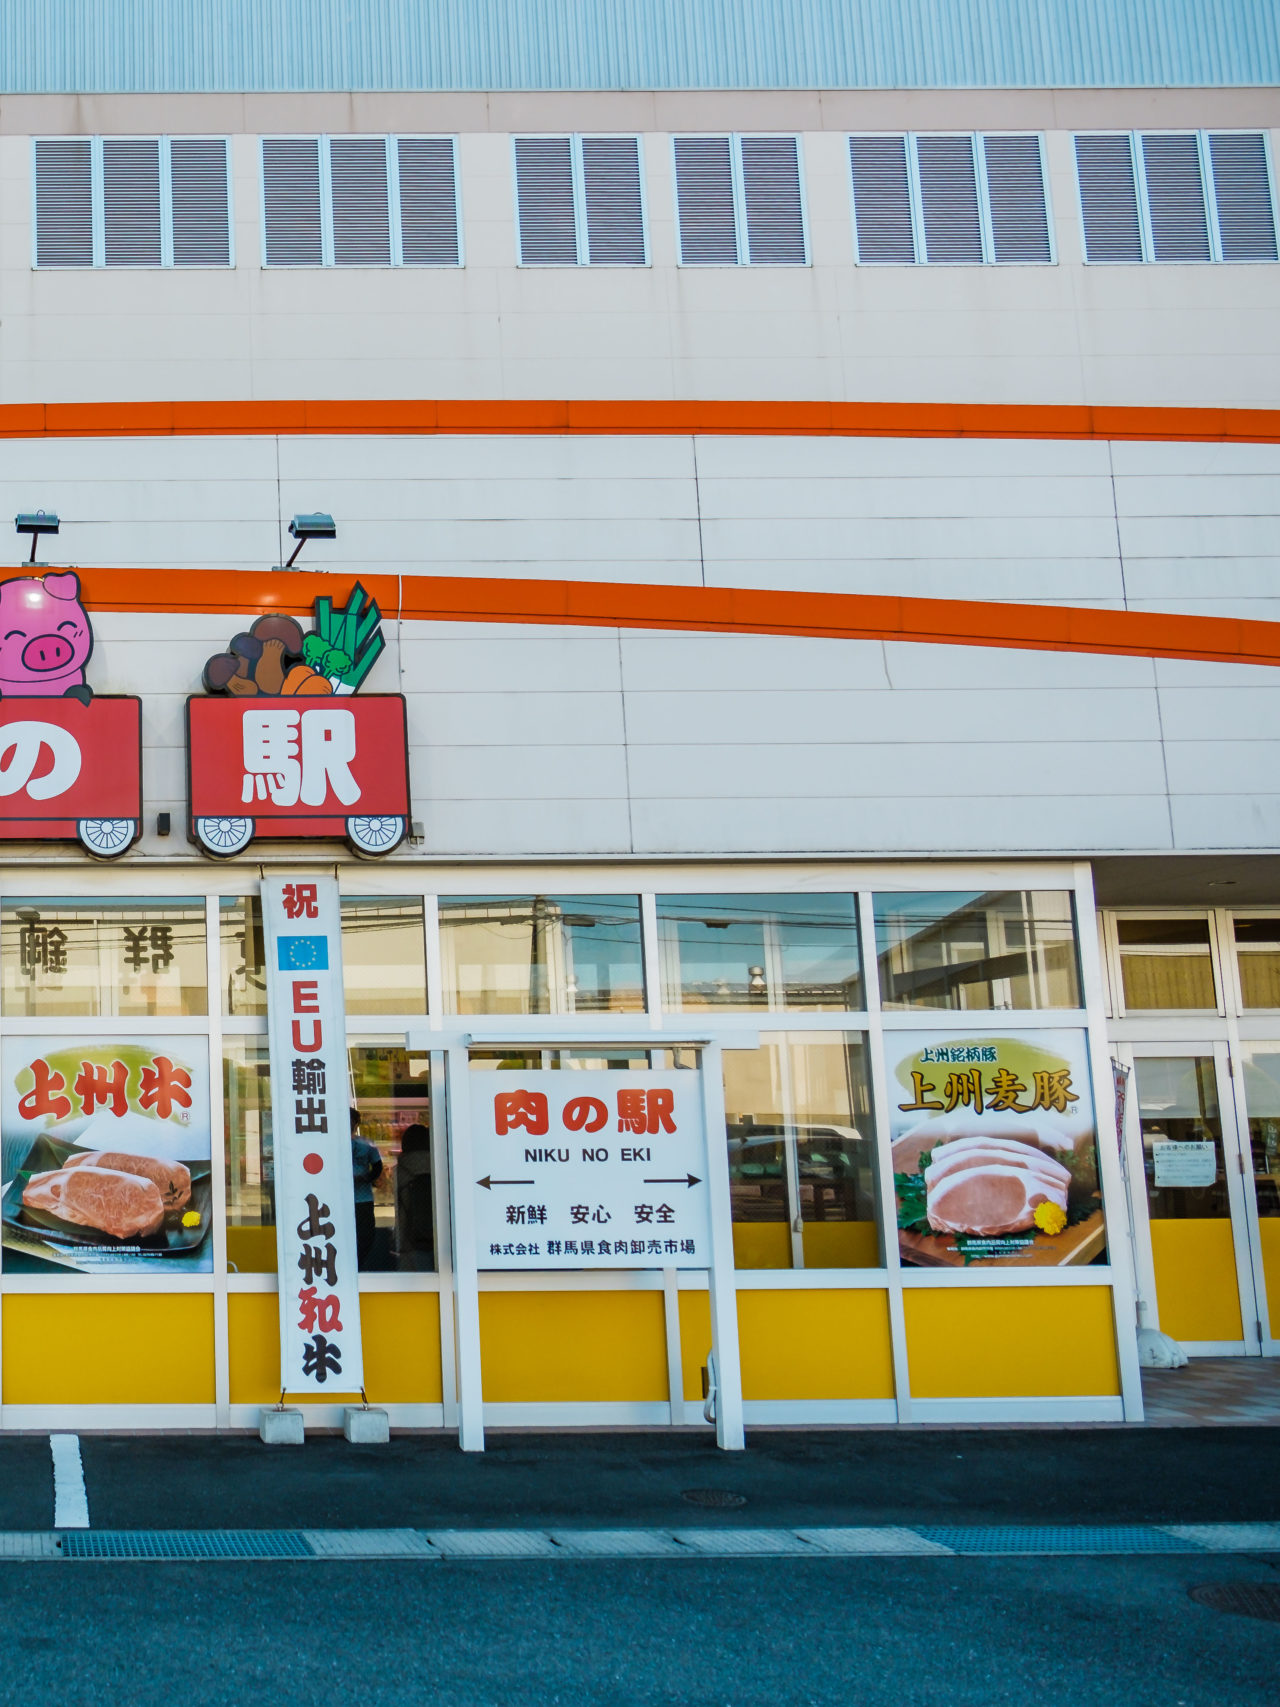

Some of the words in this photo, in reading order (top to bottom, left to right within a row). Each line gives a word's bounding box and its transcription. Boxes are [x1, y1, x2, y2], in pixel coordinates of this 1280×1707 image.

[282, 883, 318, 919] 祝
[919, 1045, 997, 1063] 上州銘柄豚
[18, 1055, 193, 1121] 上州牛
[898, 1067, 1079, 1115] 上州麦豚
[494, 1088, 677, 1136] 肉の駅
[524, 1148, 570, 1163] NIKU
[582, 1148, 609, 1163] NO
[621, 1147, 651, 1162] EKI
[505, 1204, 548, 1225] 新鮮
[570, 1204, 611, 1225] 安心
[633, 1204, 676, 1224] 安全
[489, 1243, 540, 1256] 株式会社
[547, 1239, 696, 1256] 群馬県食肉卸売市場
[296, 1193, 343, 1384] 上州和牛
